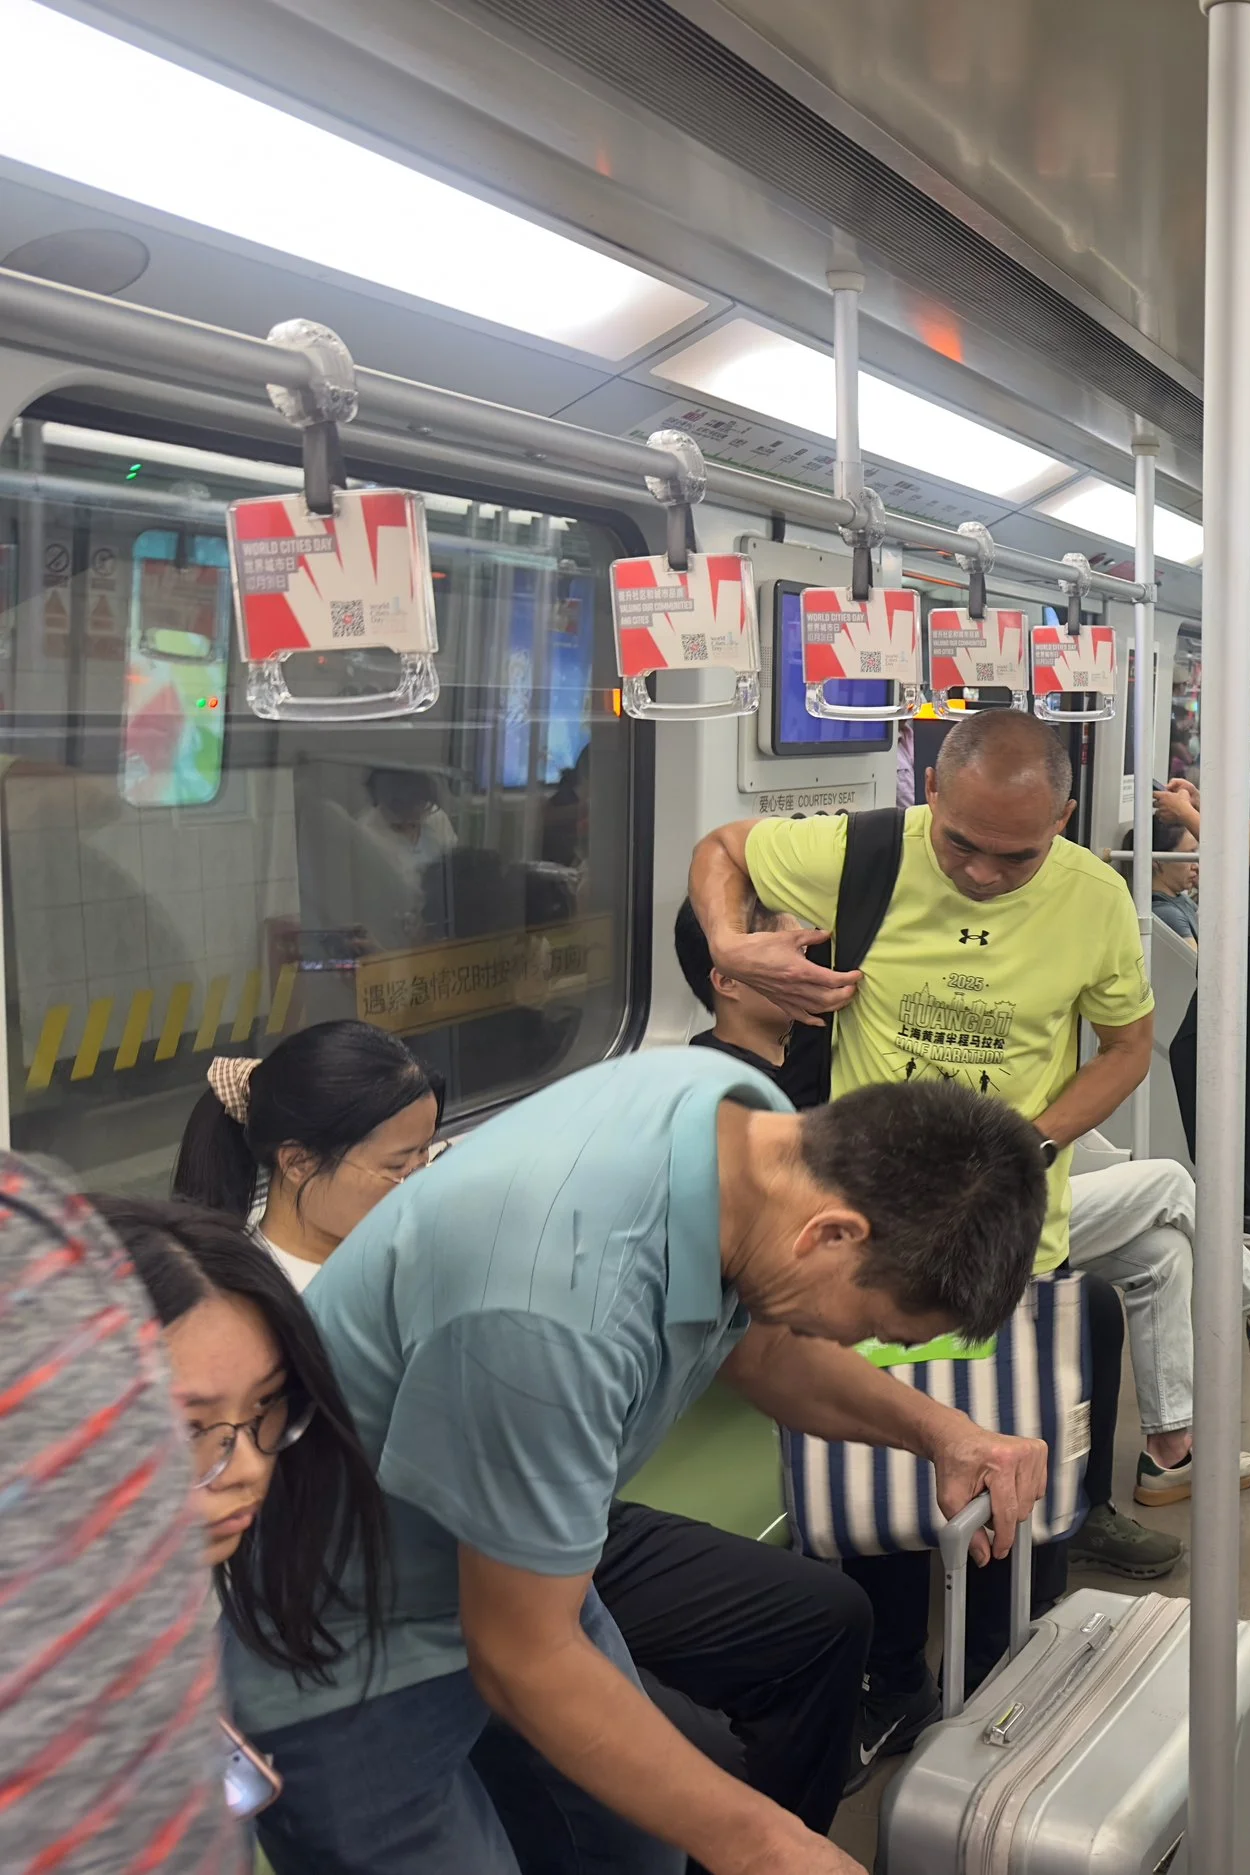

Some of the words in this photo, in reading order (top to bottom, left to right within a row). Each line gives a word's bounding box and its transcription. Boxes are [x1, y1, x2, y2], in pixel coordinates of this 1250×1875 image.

[242, 541, 278, 556] WORLD
[280, 538, 312, 554] CITIES
[313, 537, 333, 552] DAY
[243, 556, 295, 574] 世界城市日
[807, 613, 829, 622] WORLD
[831, 613, 851, 622] CITIES
[852, 613, 865, 622] DAY
[759, 794, 794, 814] 爱心专座
[797, 793, 837, 808] COURTESY
[838, 791, 856, 804] SEAT
[947, 972, 985, 992] 2025
[899, 999, 1013, 1038] HUANGPU
[897, 1023, 1006, 1050] 上海黄浦半程马拉松
[895, 1036, 931, 1058] HALF
[930, 1044, 1004, 1065] MARATHON
